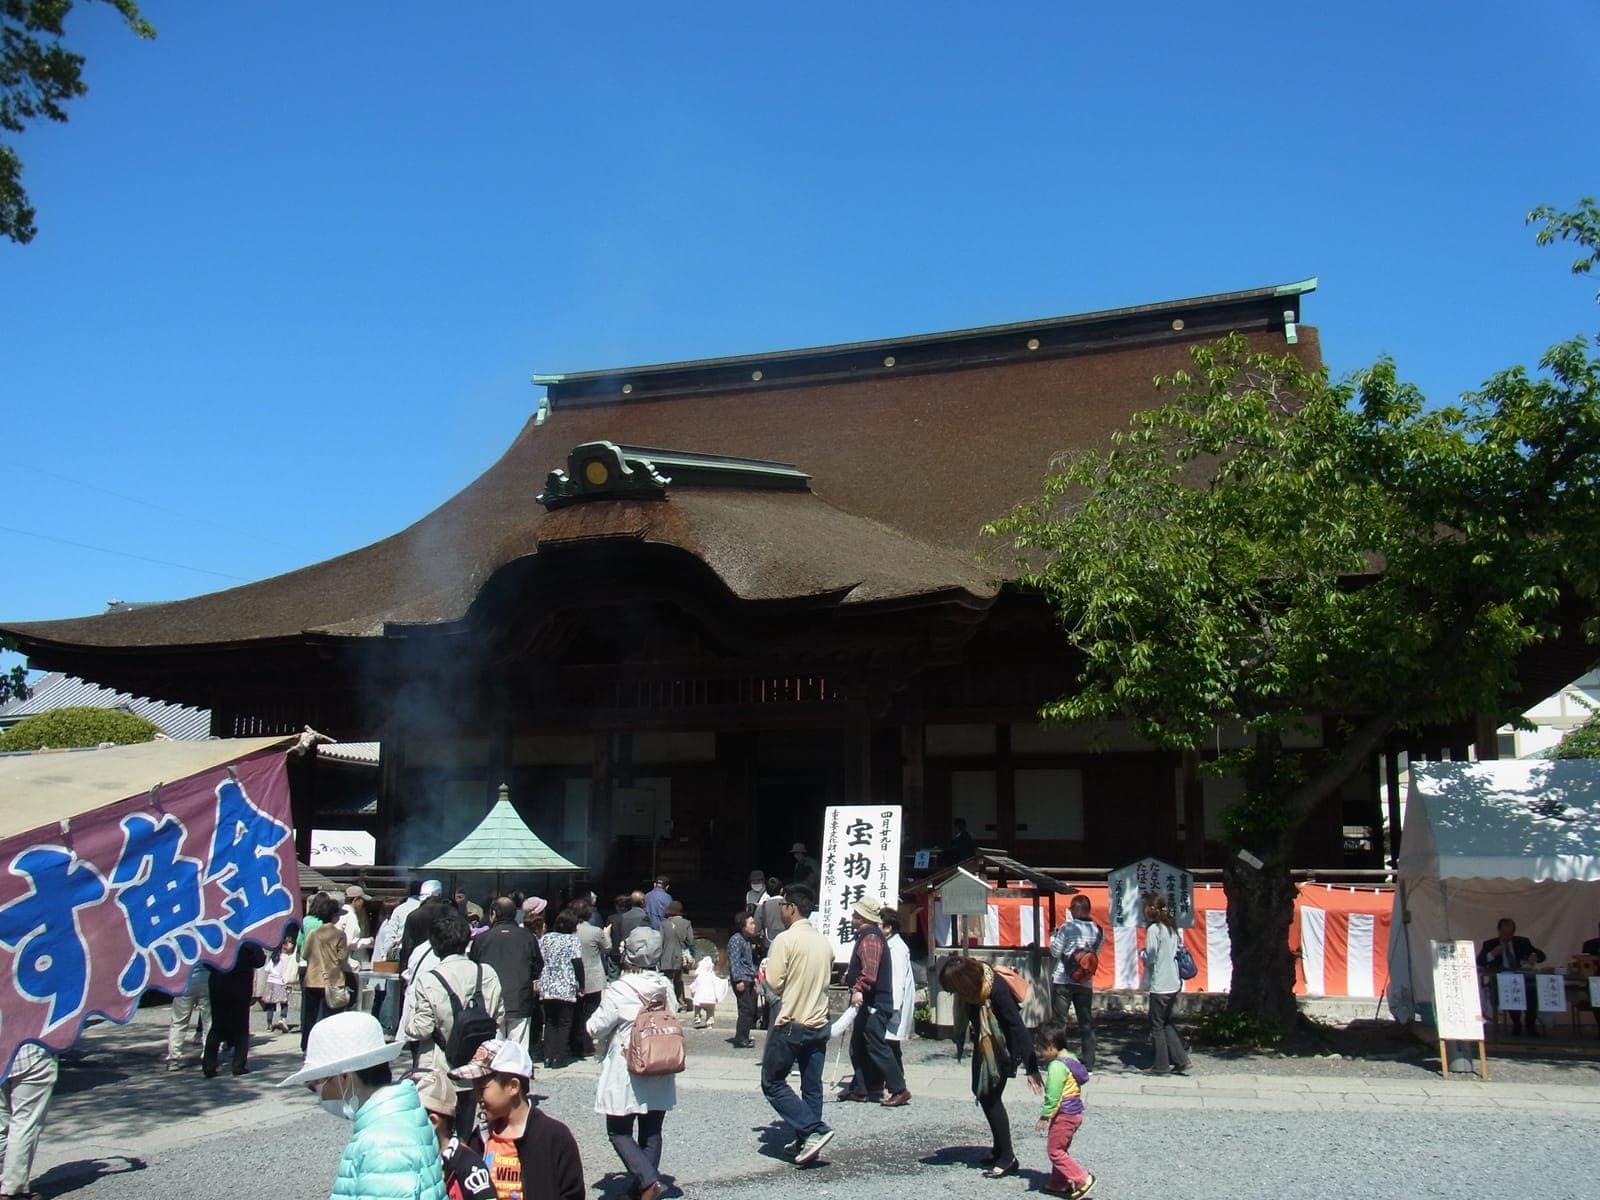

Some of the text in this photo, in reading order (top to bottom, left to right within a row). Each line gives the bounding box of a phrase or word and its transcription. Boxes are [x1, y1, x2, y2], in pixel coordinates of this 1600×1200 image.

[1136, 861, 1148, 896] たばこ
[1150, 861, 1161, 894] たき火
